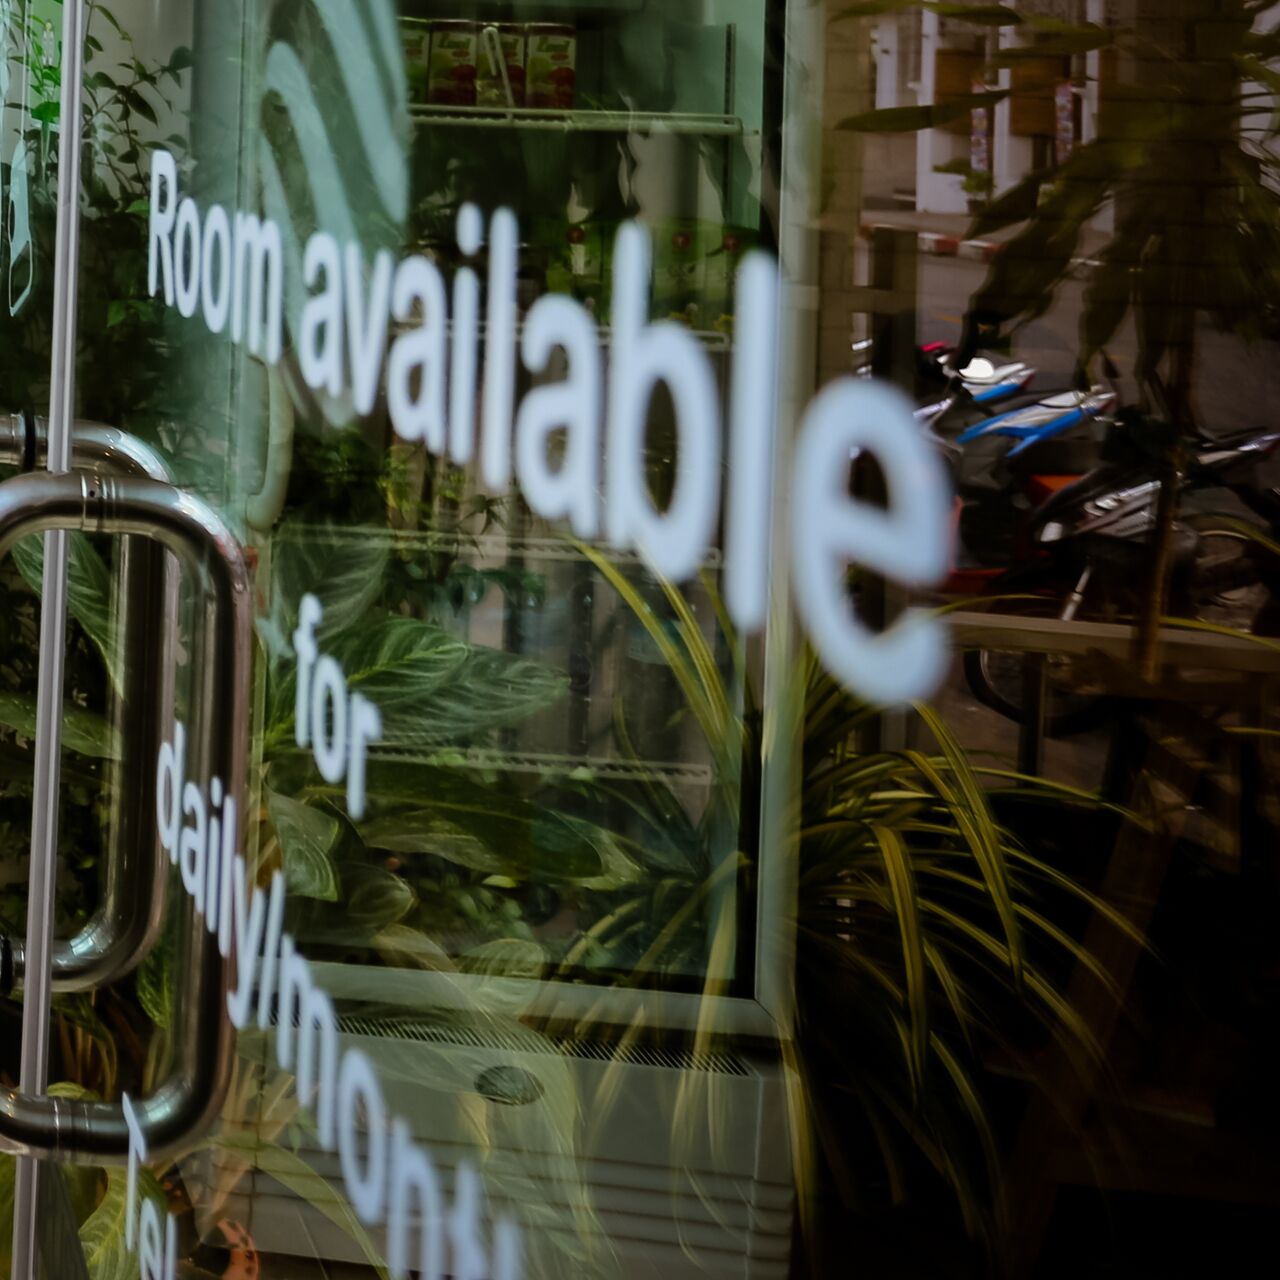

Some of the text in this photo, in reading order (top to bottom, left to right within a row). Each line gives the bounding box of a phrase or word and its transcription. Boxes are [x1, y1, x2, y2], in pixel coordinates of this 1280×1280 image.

[148, 150, 958, 705] Room available
[294, 592, 384, 820] for
